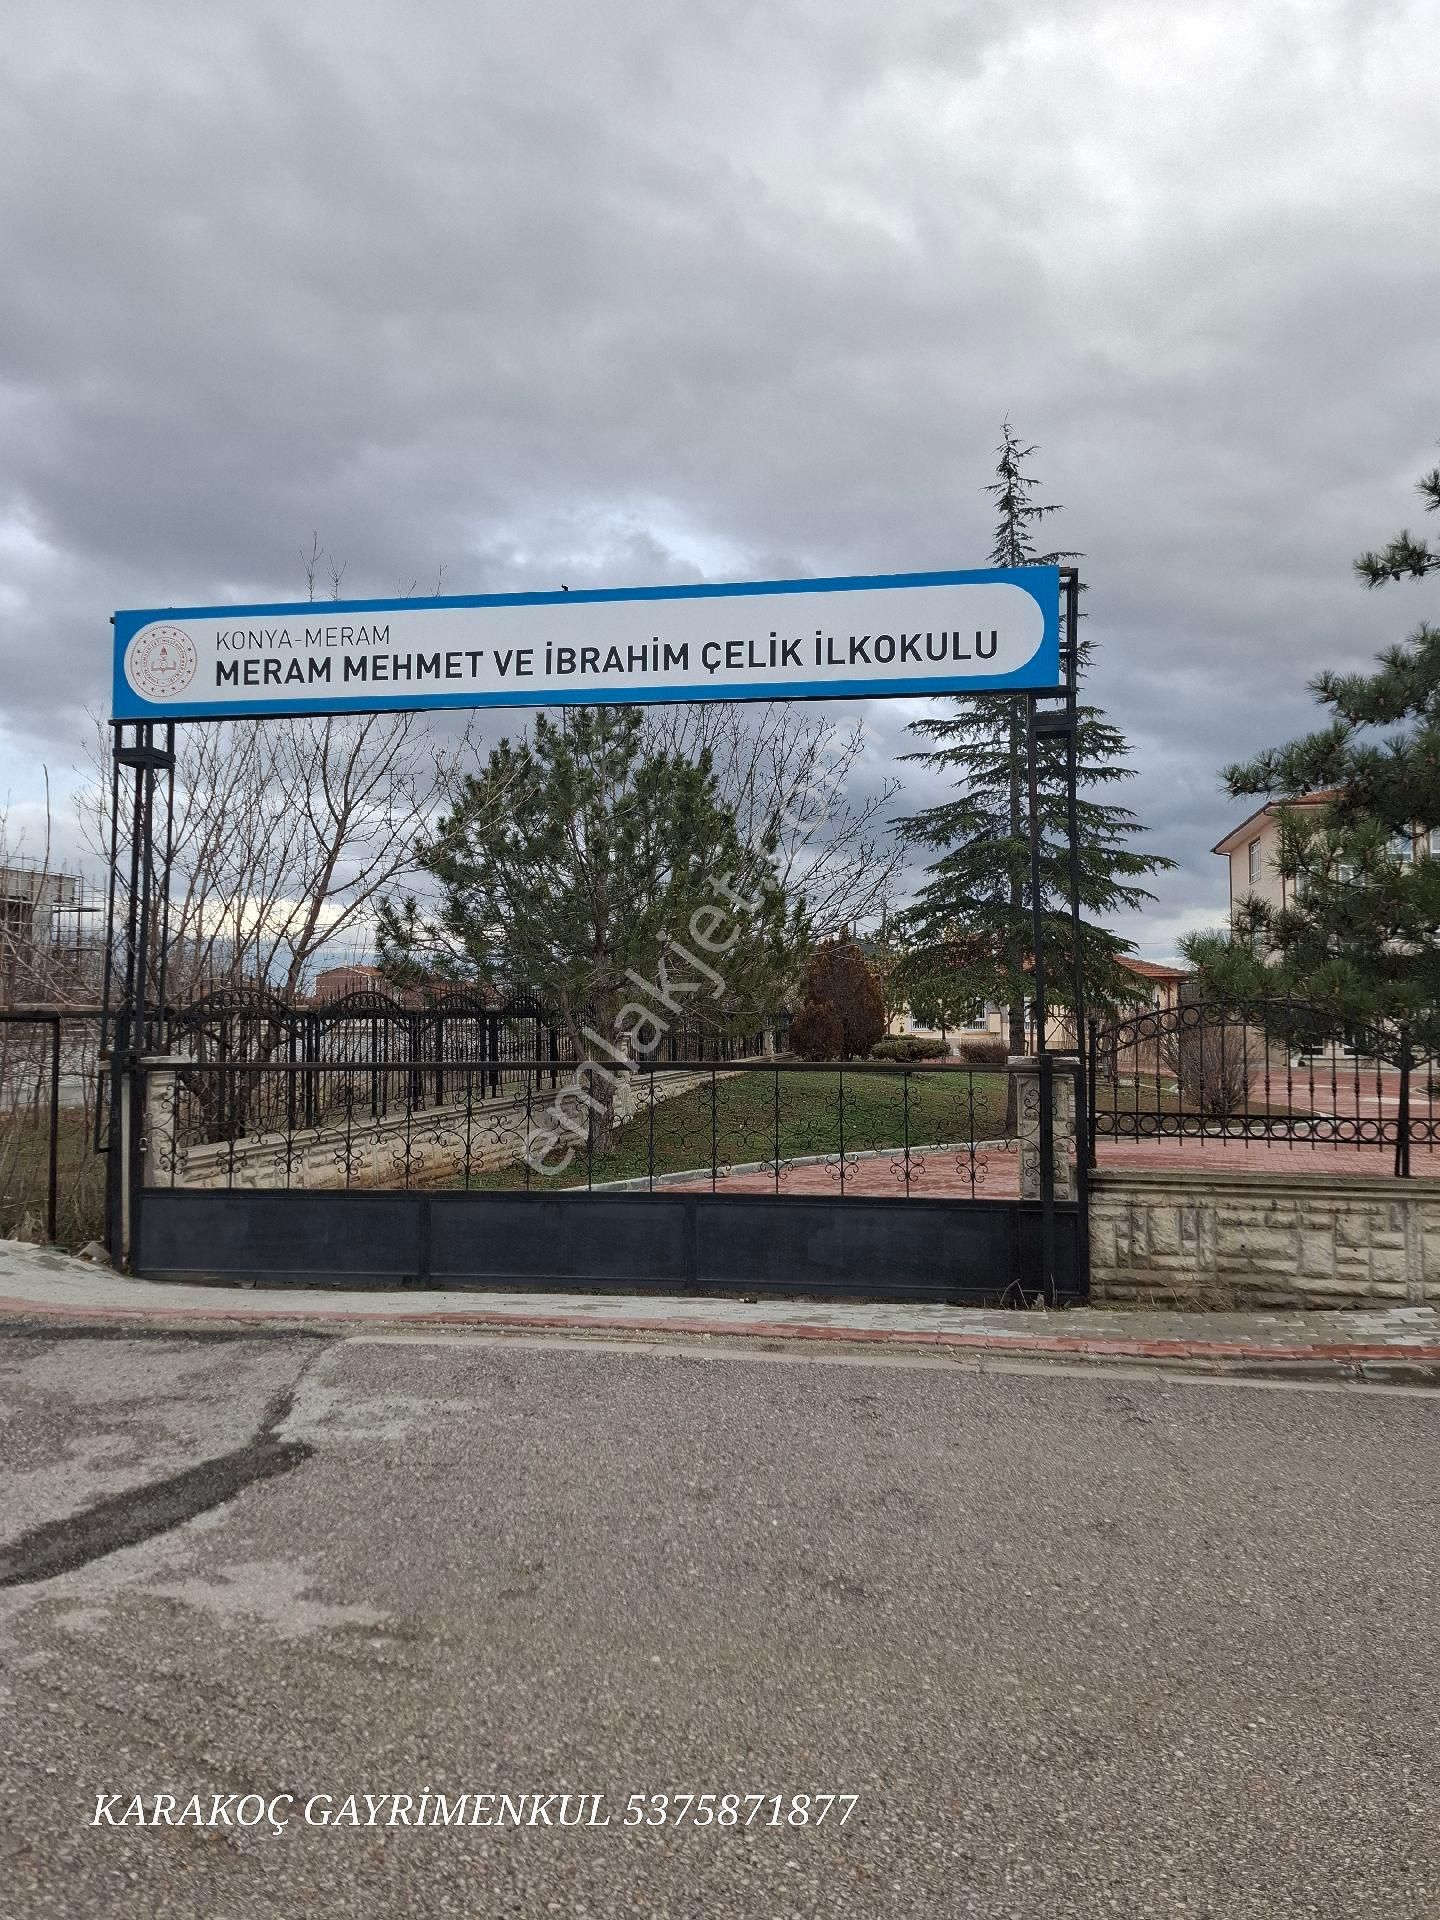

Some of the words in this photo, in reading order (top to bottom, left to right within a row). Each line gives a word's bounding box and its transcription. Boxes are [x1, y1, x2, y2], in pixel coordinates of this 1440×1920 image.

[215, 656, 332, 686] MERAM
[343, 651, 484, 682] MEHMET
[493, 648, 534, 677] VE
[545, 636, 689, 676] İBRAHİM
[701, 631, 804, 675] ÇELİK
[815, 630, 999, 666] İLKOKULU
[216, 624, 390, 651] KONYA-MERAM
